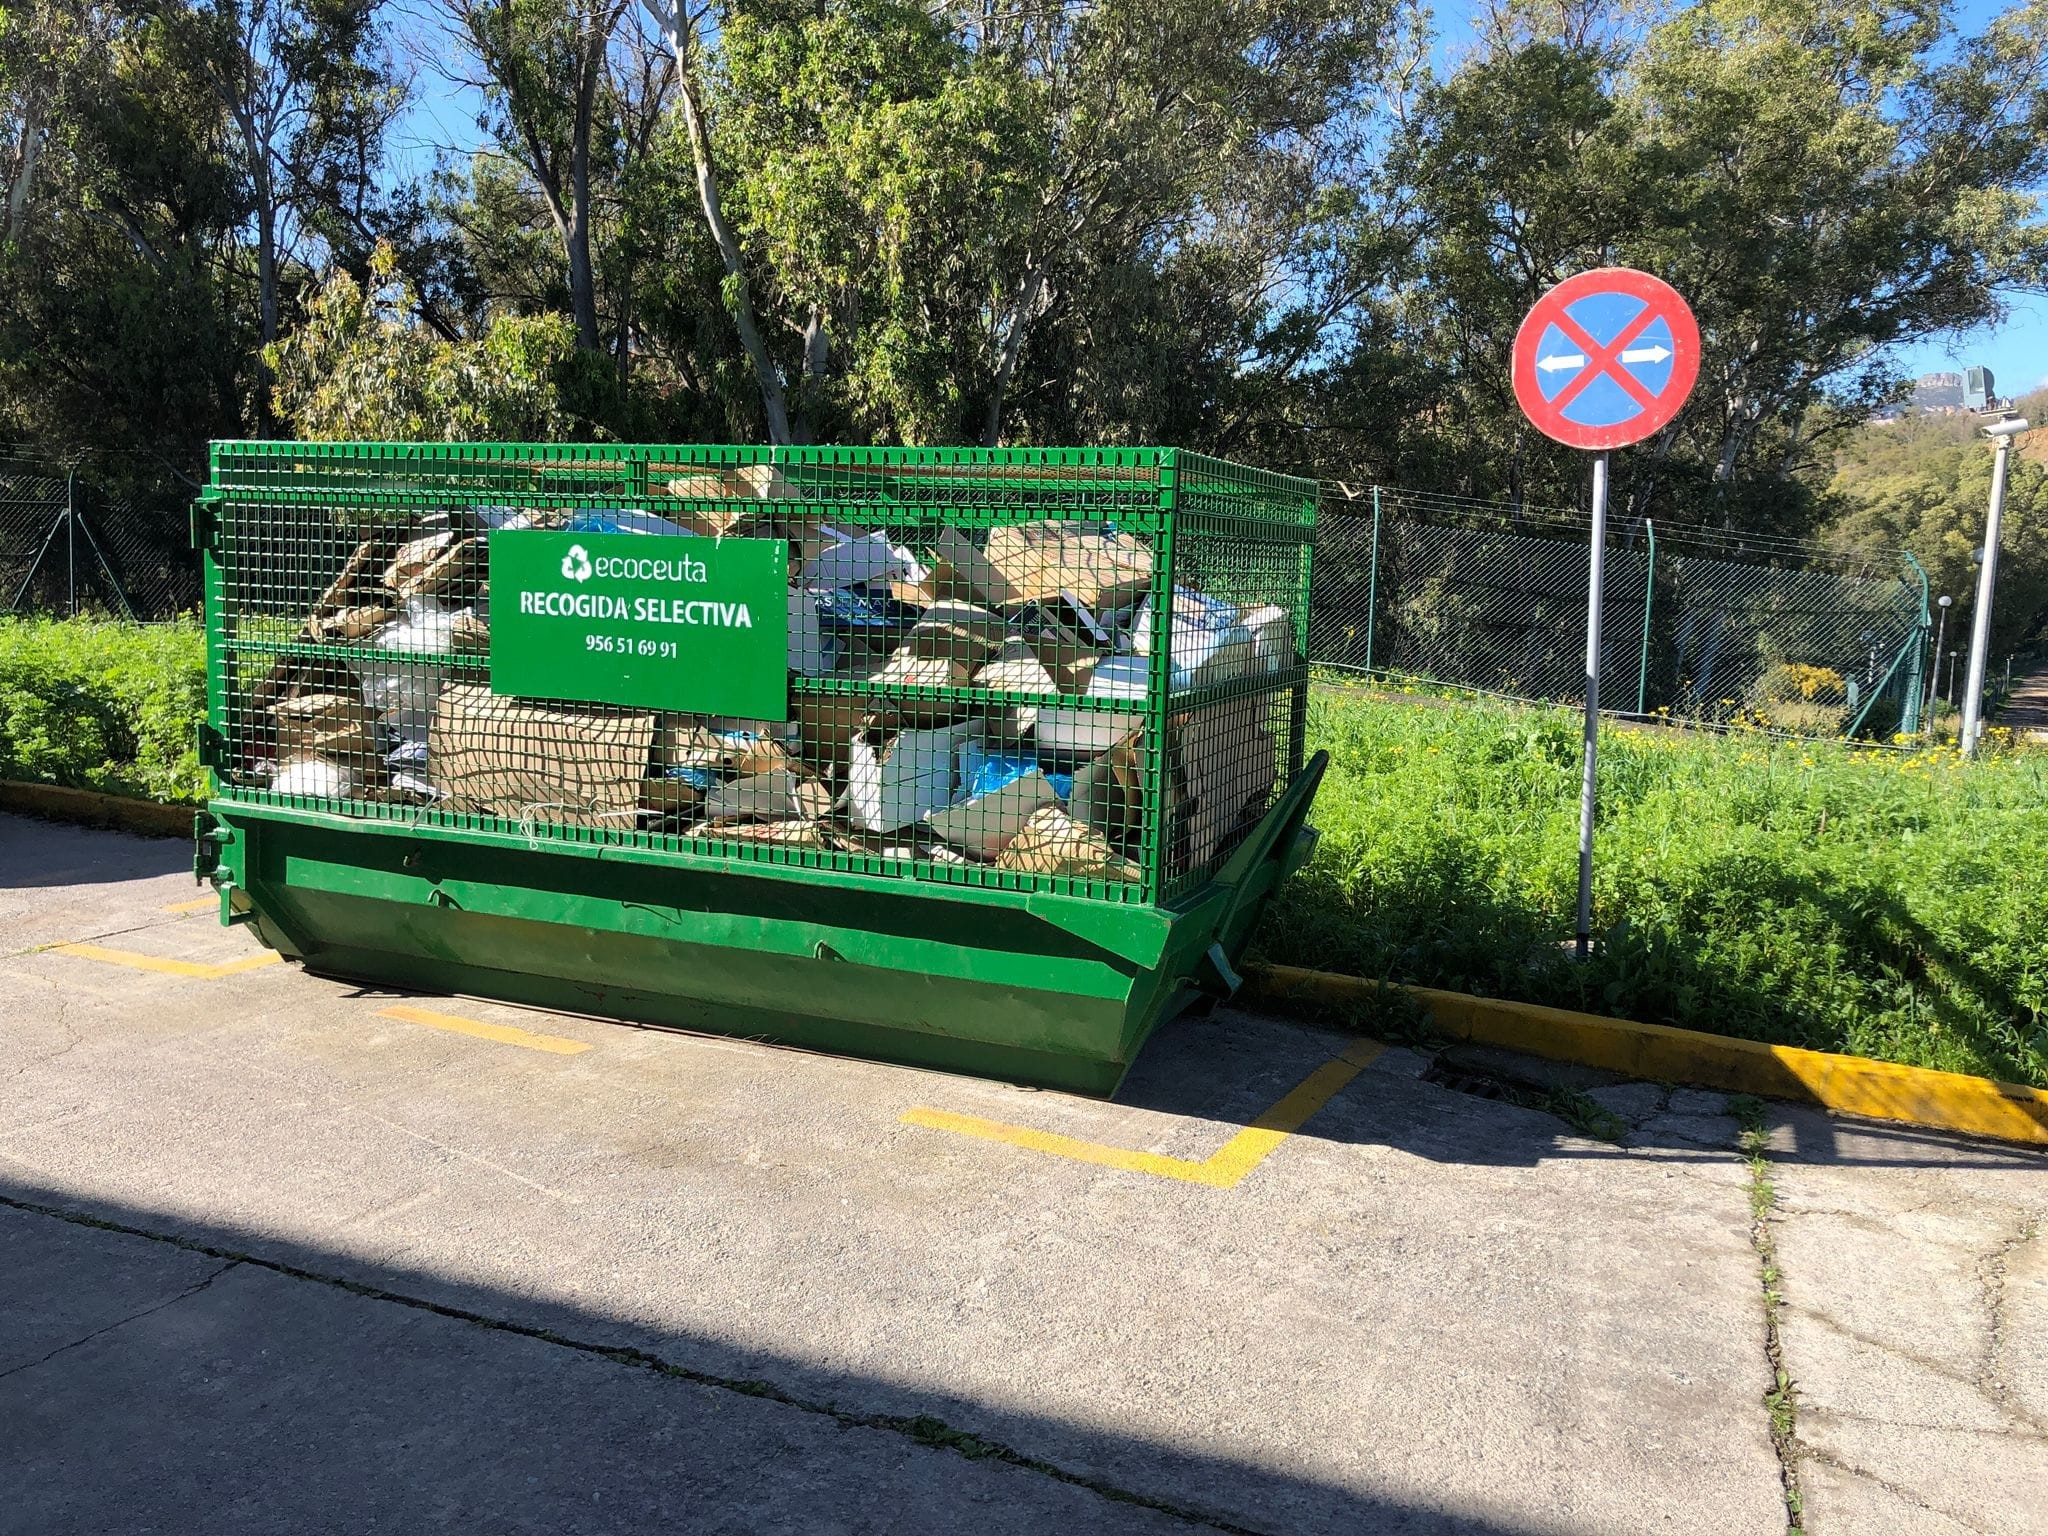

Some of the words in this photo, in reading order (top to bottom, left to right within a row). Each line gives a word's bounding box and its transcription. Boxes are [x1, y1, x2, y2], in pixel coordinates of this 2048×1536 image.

[596, 553, 708, 583] ecoceuta
[520, 591, 629, 620] RECOGIDA
[633, 597, 753, 628] SELECTIVA
[585, 634, 614, 653] 956
[616, 637, 633, 655] 51
[638, 639, 657, 657] 69
[659, 641, 678, 659] 91
